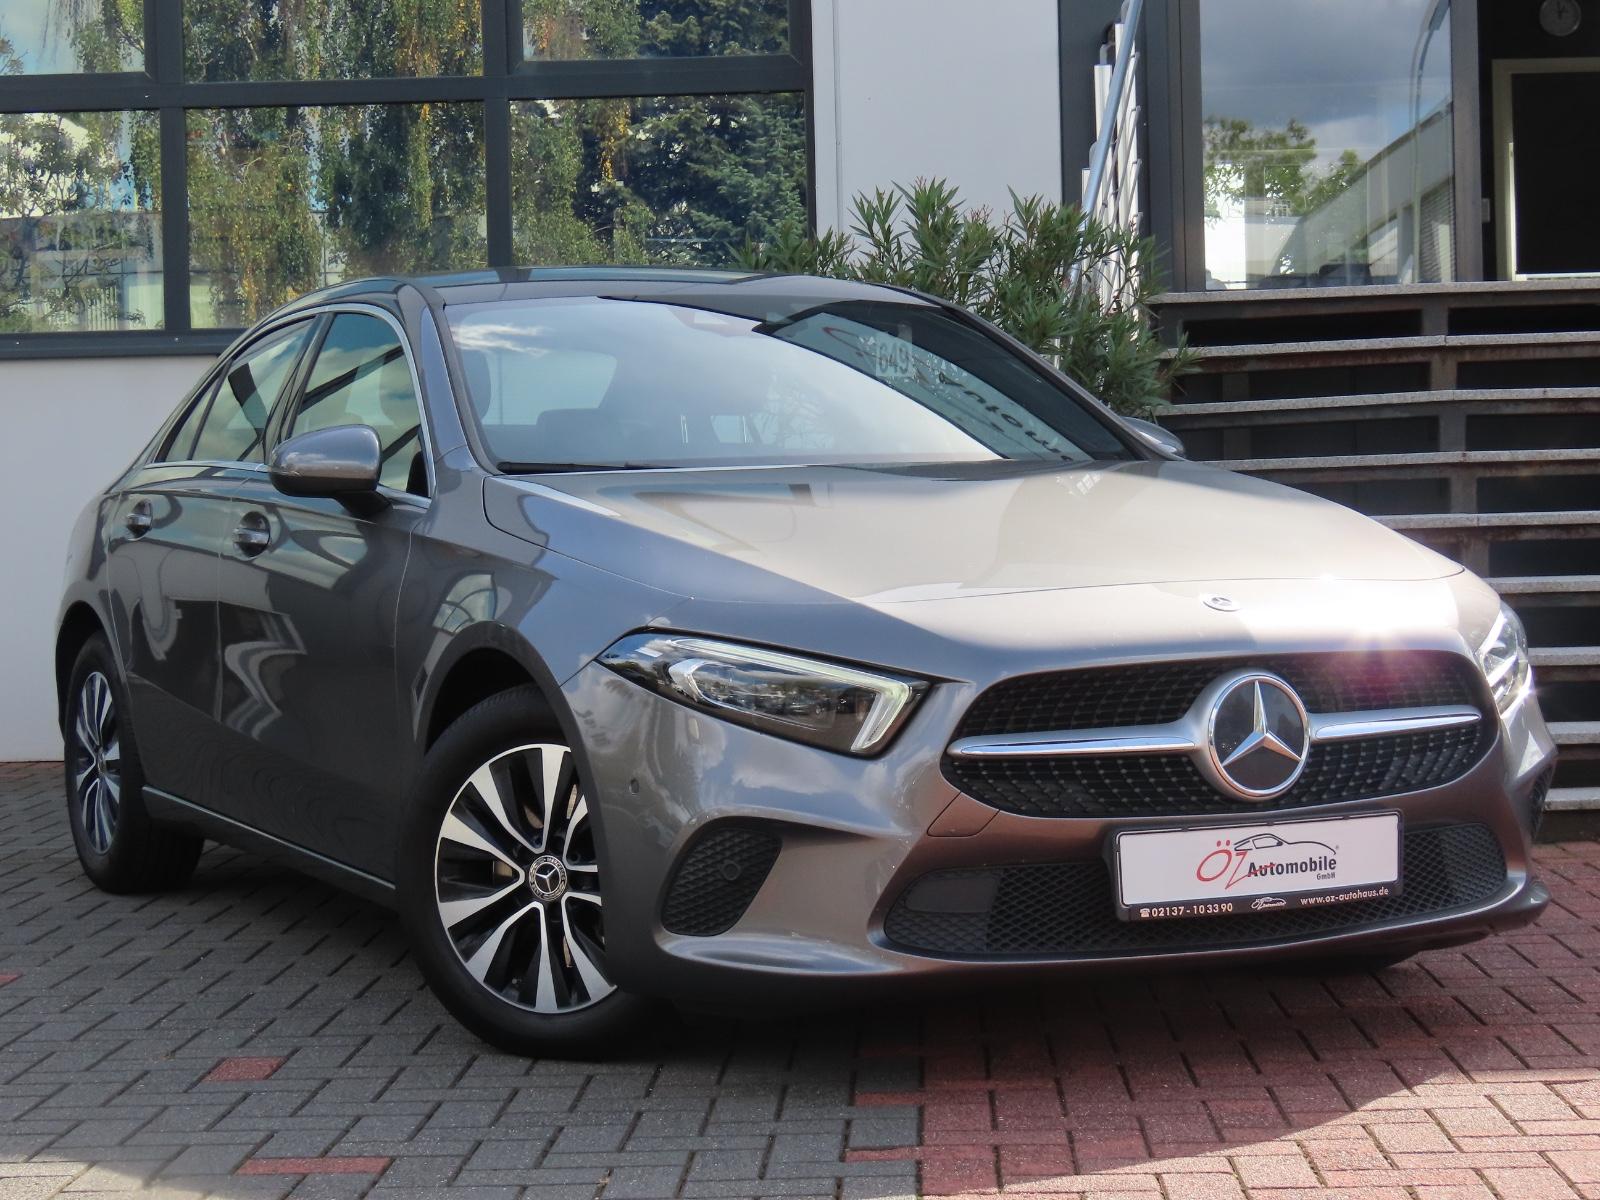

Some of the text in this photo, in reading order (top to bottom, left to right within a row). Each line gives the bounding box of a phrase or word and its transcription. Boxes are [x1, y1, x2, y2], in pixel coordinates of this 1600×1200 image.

[1196, 839, 1337, 889] ÖZ Automobile
[1316, 872, 1336, 881] GmbH
[1300, 886, 1389, 905] www.oz-autohaus.de
